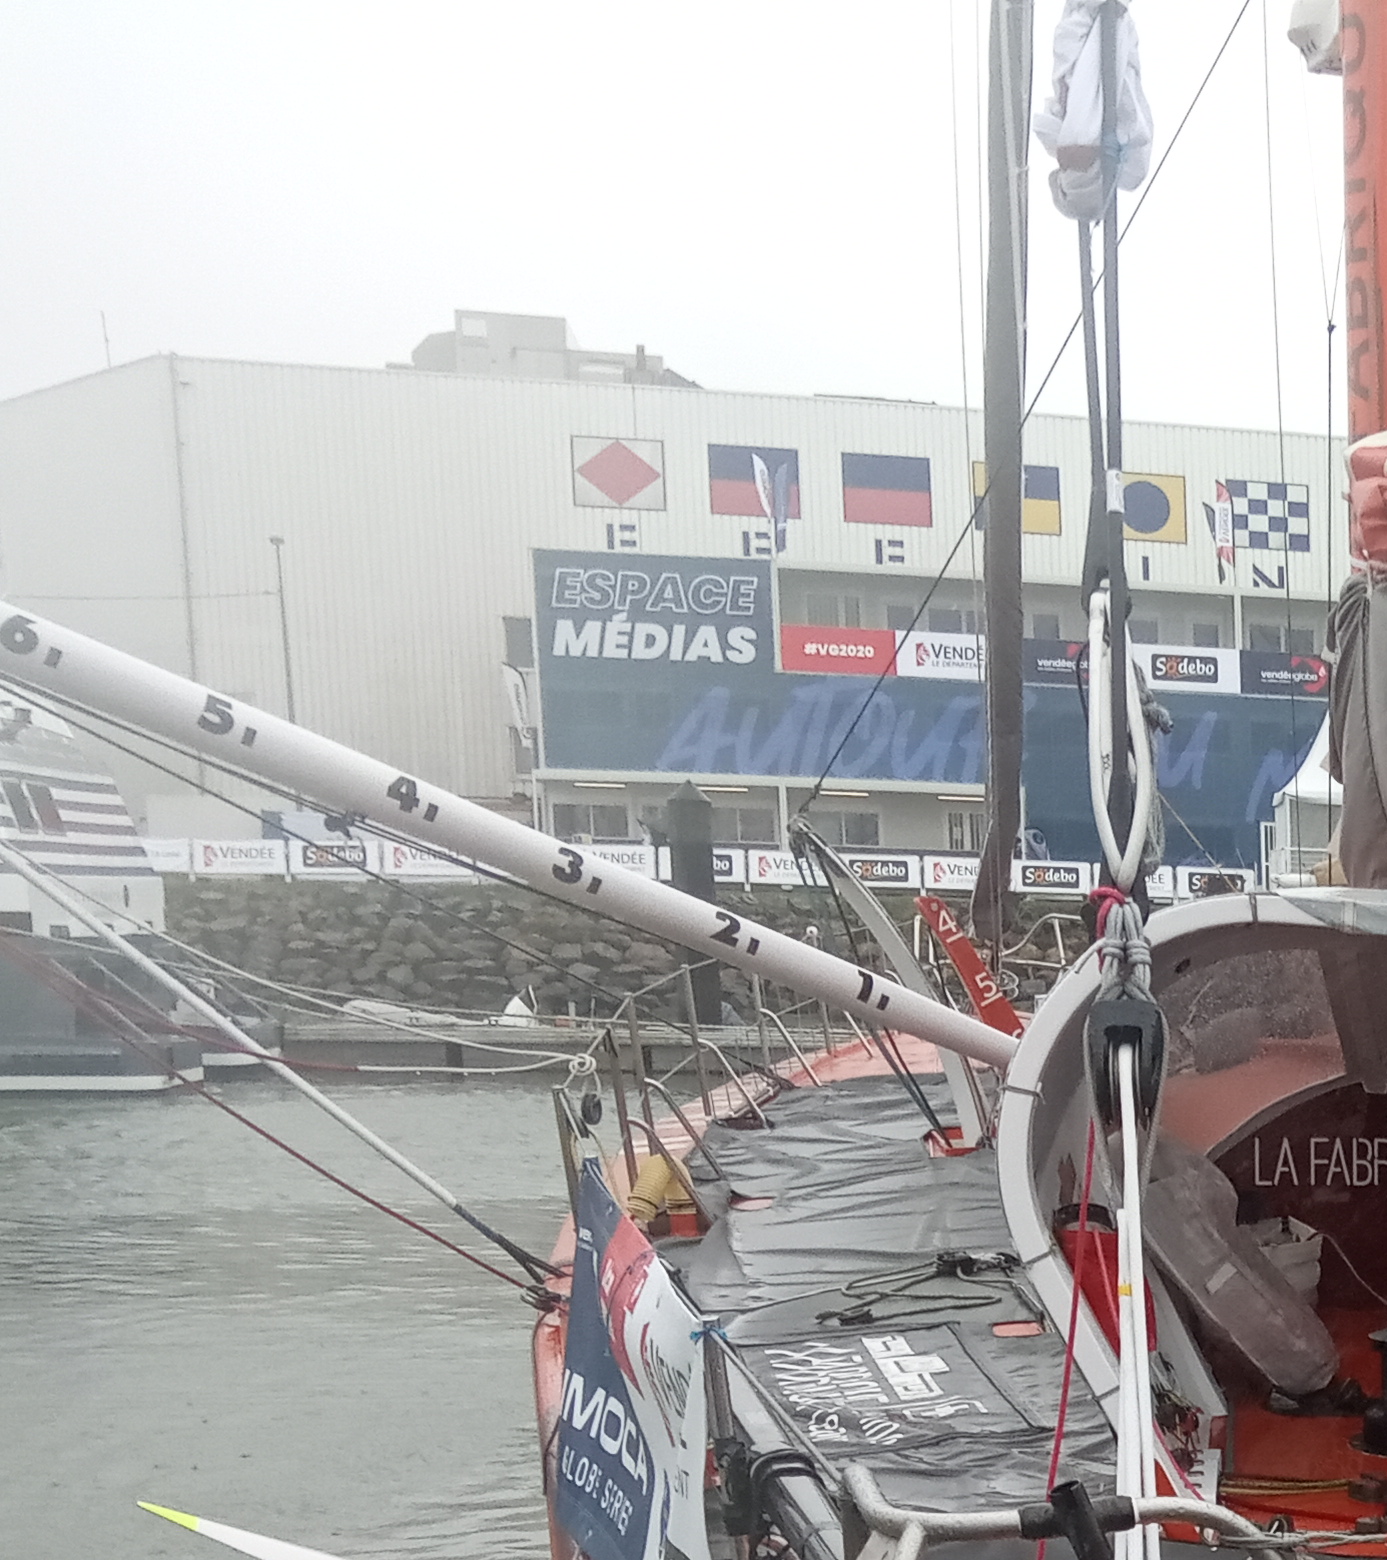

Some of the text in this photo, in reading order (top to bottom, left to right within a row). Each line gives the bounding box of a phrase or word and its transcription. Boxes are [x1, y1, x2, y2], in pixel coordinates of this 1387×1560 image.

[551, 567, 757, 615] ESPACE
[0, 614, 39, 655] 6
[552, 611, 757, 663] MÉDIAS
[804, 642, 875, 658] #VG2020
[931, 642, 984, 663] VENDÉ
[198, 694, 235, 735] 5
[387, 776, 420, 814] 4
[552, 847, 584, 884] 3
[710, 911, 741, 948] 2
[1253, 1137, 1299, 1187] LA
[561, 1368, 648, 1496] IMOCA
